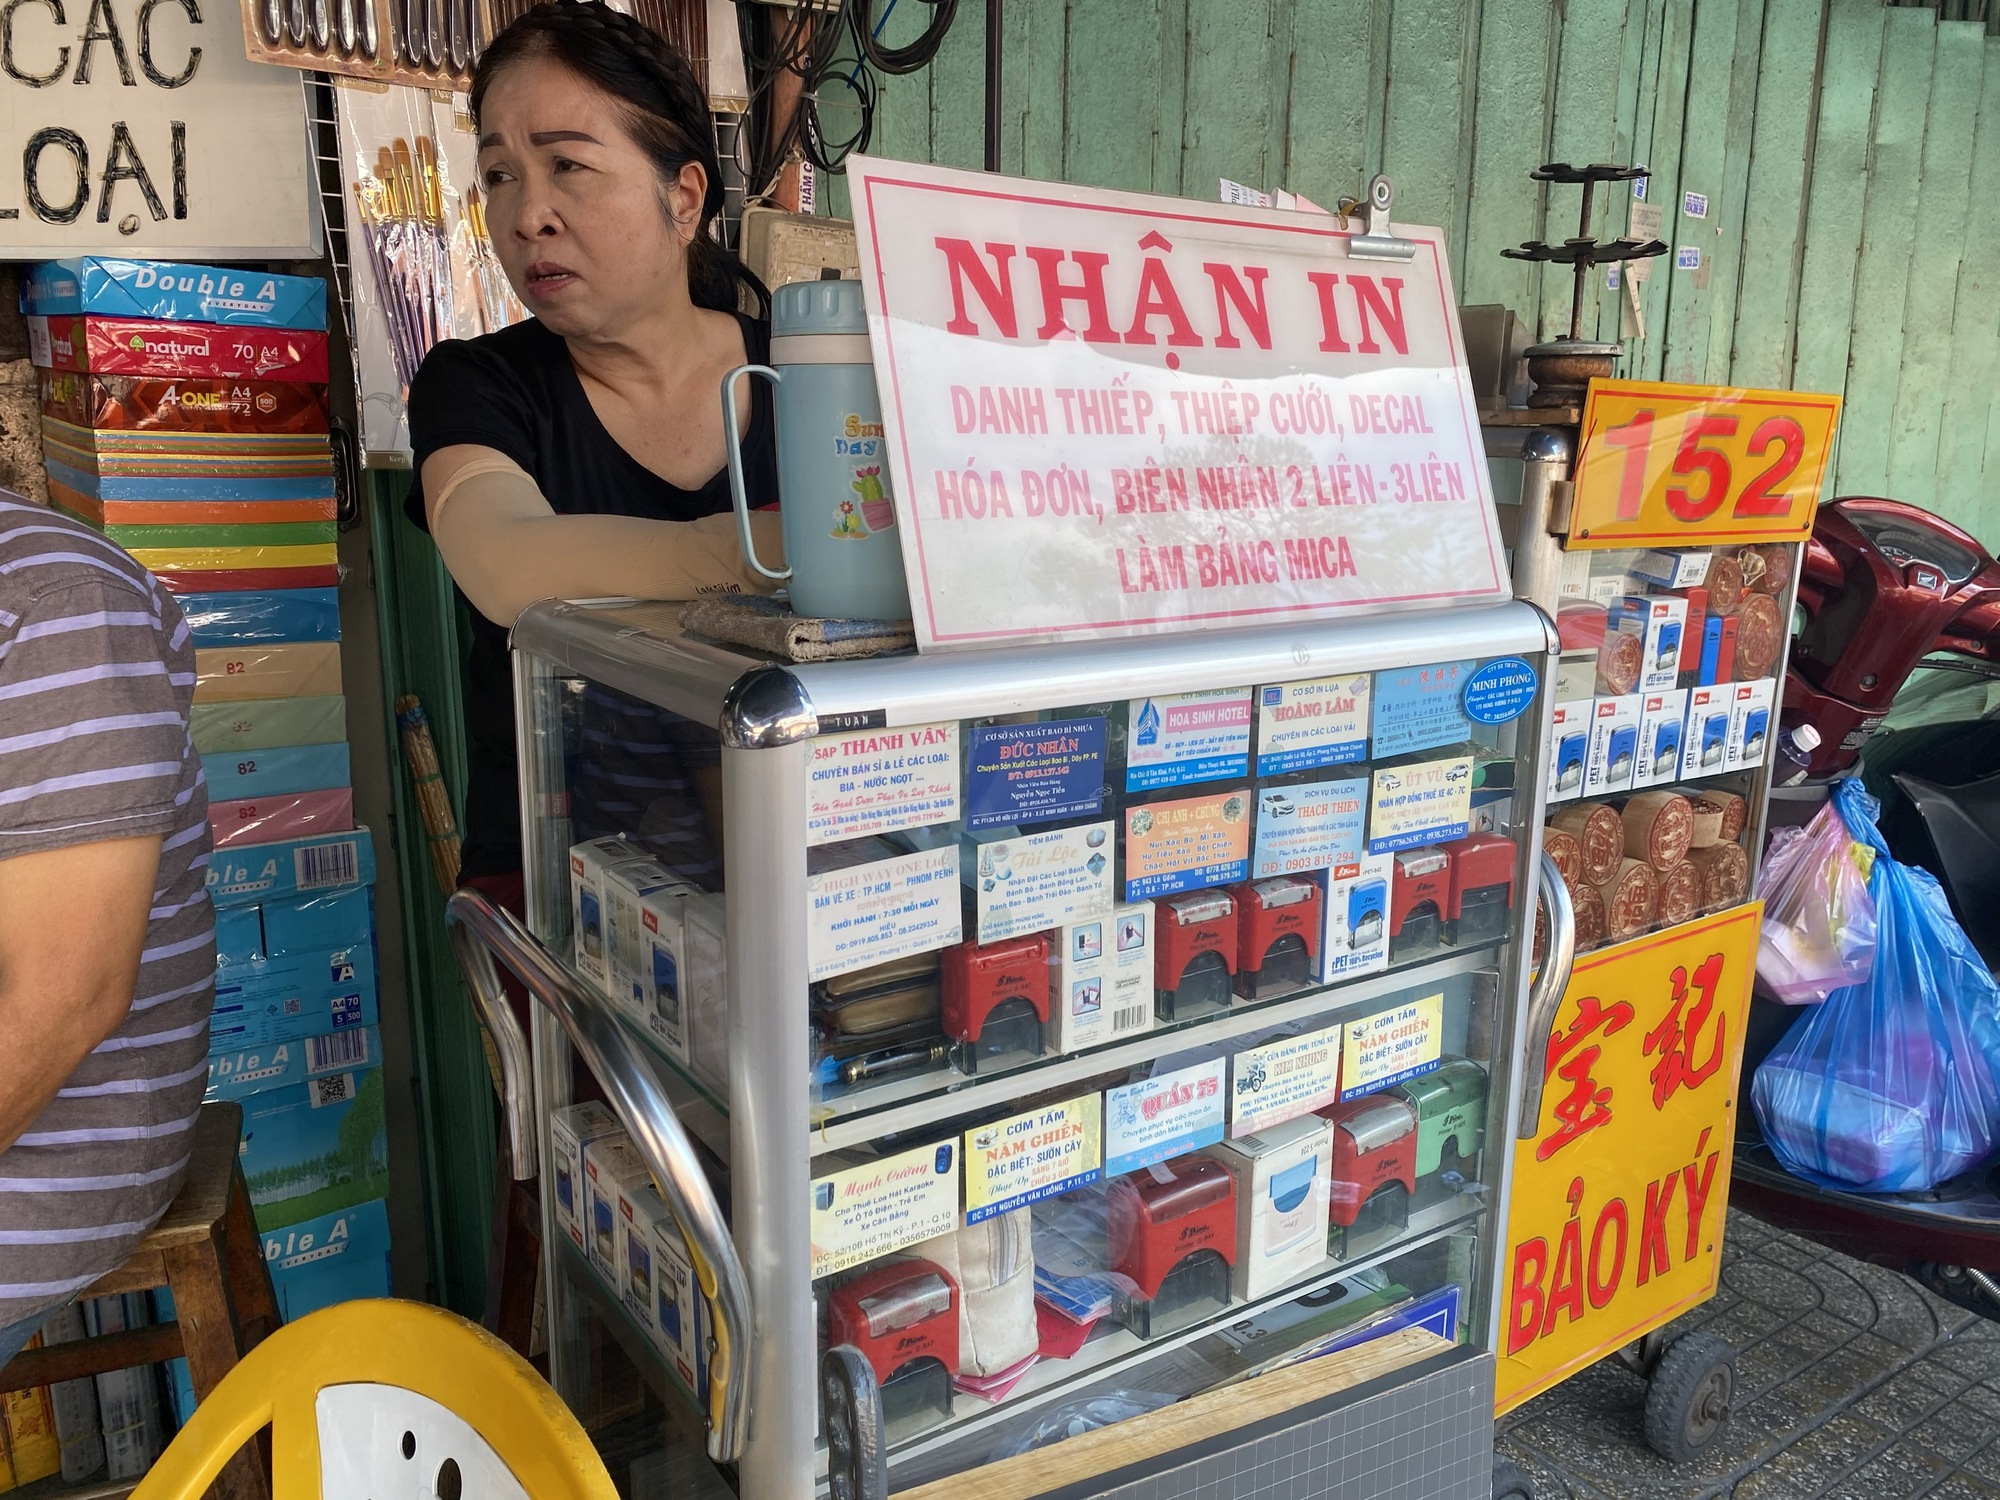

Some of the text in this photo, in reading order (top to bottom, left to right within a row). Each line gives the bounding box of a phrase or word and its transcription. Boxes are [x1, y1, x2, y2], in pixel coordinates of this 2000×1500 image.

[0, 120, 189, 236] OẠI
[135, 268, 277, 300] Double A
[208, 300, 264, 310] EVERYDAY
[934, 229, 1409, 371] NHẬN IN
[144, 340, 278, 359] natural 70 A4
[231, 387, 251, 398] A4
[232, 403, 250, 414] 72
[950, 372, 1433, 445] DANH THIẾP, THIỆP CƯỚI, DECAL
[835, 439, 877, 456] Day
[1604, 408, 1806, 523] 152
[935, 457, 1011, 520] HÓA
[1022, 464, 1104, 523] ĐƠN,
[1115, 454, 1188, 515] BIÊN
[1197, 454, 1278, 518] NHẬN
[1291, 468, 1308, 507] 2
[1117, 525, 1357, 595] LÀM BẢNG MICA
[226, 662, 245, 675] 82
[1472, 673, 1531, 692] MINH PHONG
[1170, 706, 1249, 726] HOA SINH HOTEL
[1275, 696, 1355, 722] HOÀNG LÂM
[815, 727, 948, 760] SẠP THANH VÂN
[1000, 736, 1079, 760] ĐỨC NHÂN
[238, 761, 257, 775] 82
[1406, 767, 1444, 787] ÚT VŨ
[839, 773, 913, 793] BIA NƯỚC NGỌT
[1010, 789, 1050, 800] Nguyễn Ngọc
[1304, 790, 1320, 798] DỊCH
[1341, 786, 1355, 794] LỊCH
[239, 806, 257, 819] 82
[1297, 803, 1328, 819] THẠCH
[1028, 834, 1064, 846] TIỆM BÁNH
[1012, 845, 1078, 870] Tài Lộc
[1262, 851, 1354, 874] DĐ: 0903 815 294
[205, 858, 277, 886] ble A
[824, 876, 859, 893] HIGH
[862, 867, 893, 883] WAY
[896, 861, 922, 875] ONE
[814, 897, 830, 909] BÁN
[833, 892, 843, 904] VÉ
[845, 889, 855, 900] XE
[863, 882, 891, 897] TP.HCM
[906, 872, 932, 886] PHNOM
[934, 867, 954, 880] PENH
[830, 919, 852, 932] KHỞI
[854, 914, 876, 926] HÀNH
[883, 908, 901, 918] 7:30
[903, 903, 918, 913] MỖI
[920, 898, 940, 908] NGÀY
[879, 922, 896, 932] HIẾU
[1332, 950, 1383, 969] rPET 100% Recycled
[332, 997, 359, 1009] A4 70
[337, 1011, 361, 1023] 5 500
[1375, 1007, 1416, 1029] CƠM TẤM
[209, 1044, 289, 1078] ble A
[1274, 1049, 1328, 1077] KIM NHUNG
[228, 1068, 280, 1083] EVERYDAY
[1141, 1076, 1219, 1120] QUÁN 75
[1007, 1109, 1065, 1136] CƠM TẤM
[1122, 1126, 1147, 1138] Chuyên
[1148, 1121, 1164, 1132] phục
[1174, 1114, 1186, 1122] các
[1188, 1109, 1202, 1118] món
[986, 1120, 1083, 1163] NĂM GHIỀN
[987, 1140, 1081, 1179] ĐẶC BIỆT: SƯỜN CÂY
[843, 1163, 928, 1197] Mạnh Cường
[835, 1179, 934, 1217] Cho Thuê Loa Hát Karaoke
[843, 1194, 926, 1226] Xe Ô Tô Điện Trẻ Em
[972, 1211, 984, 1221] ĐC:
[985, 1206, 997, 1216] 251
[999, 1196, 1025, 1211] NGUYỄN
[1028, 1191, 1041, 1201] VĂN
[1086, 1174, 1096, 1182] Q.6
[860, 1209, 909, 1231] Xe Cân Bằng
[265, 1218, 348, 1261] ble A
[816, 1223, 951, 1275] ĐT: 0916.242.666 0356575009
[1507, 1126, 1721, 1358] BẢO KÝ
[278, 1246, 340, 1268] EVERYDAY
[1232, 1320, 1268, 1340] Q.3
